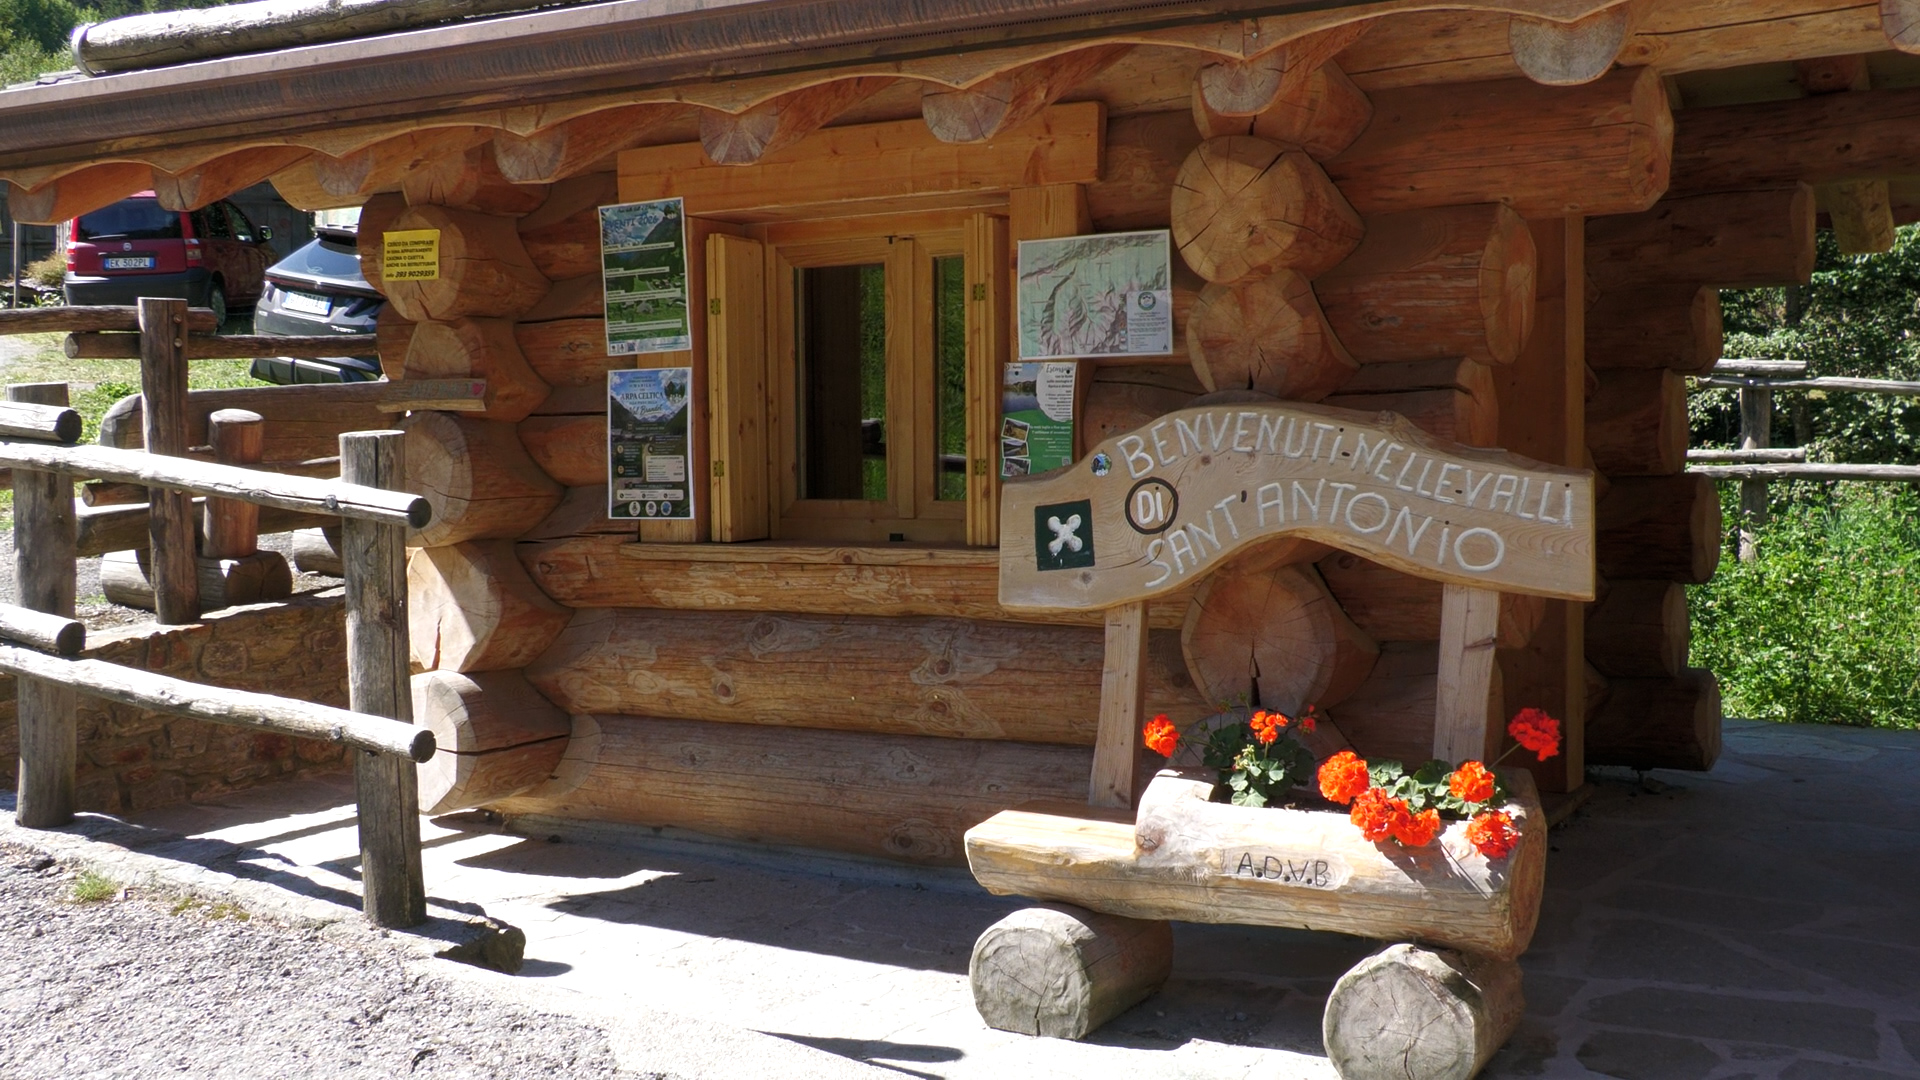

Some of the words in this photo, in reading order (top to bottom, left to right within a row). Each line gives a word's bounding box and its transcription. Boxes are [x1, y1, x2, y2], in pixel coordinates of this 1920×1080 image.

[638, 391, 664, 400] CELTICA
[1117, 413, 1344, 479] BENVENUTI
[1351, 433, 1462, 503] NELLE
[1466, 470, 1573, 529] VALLI
